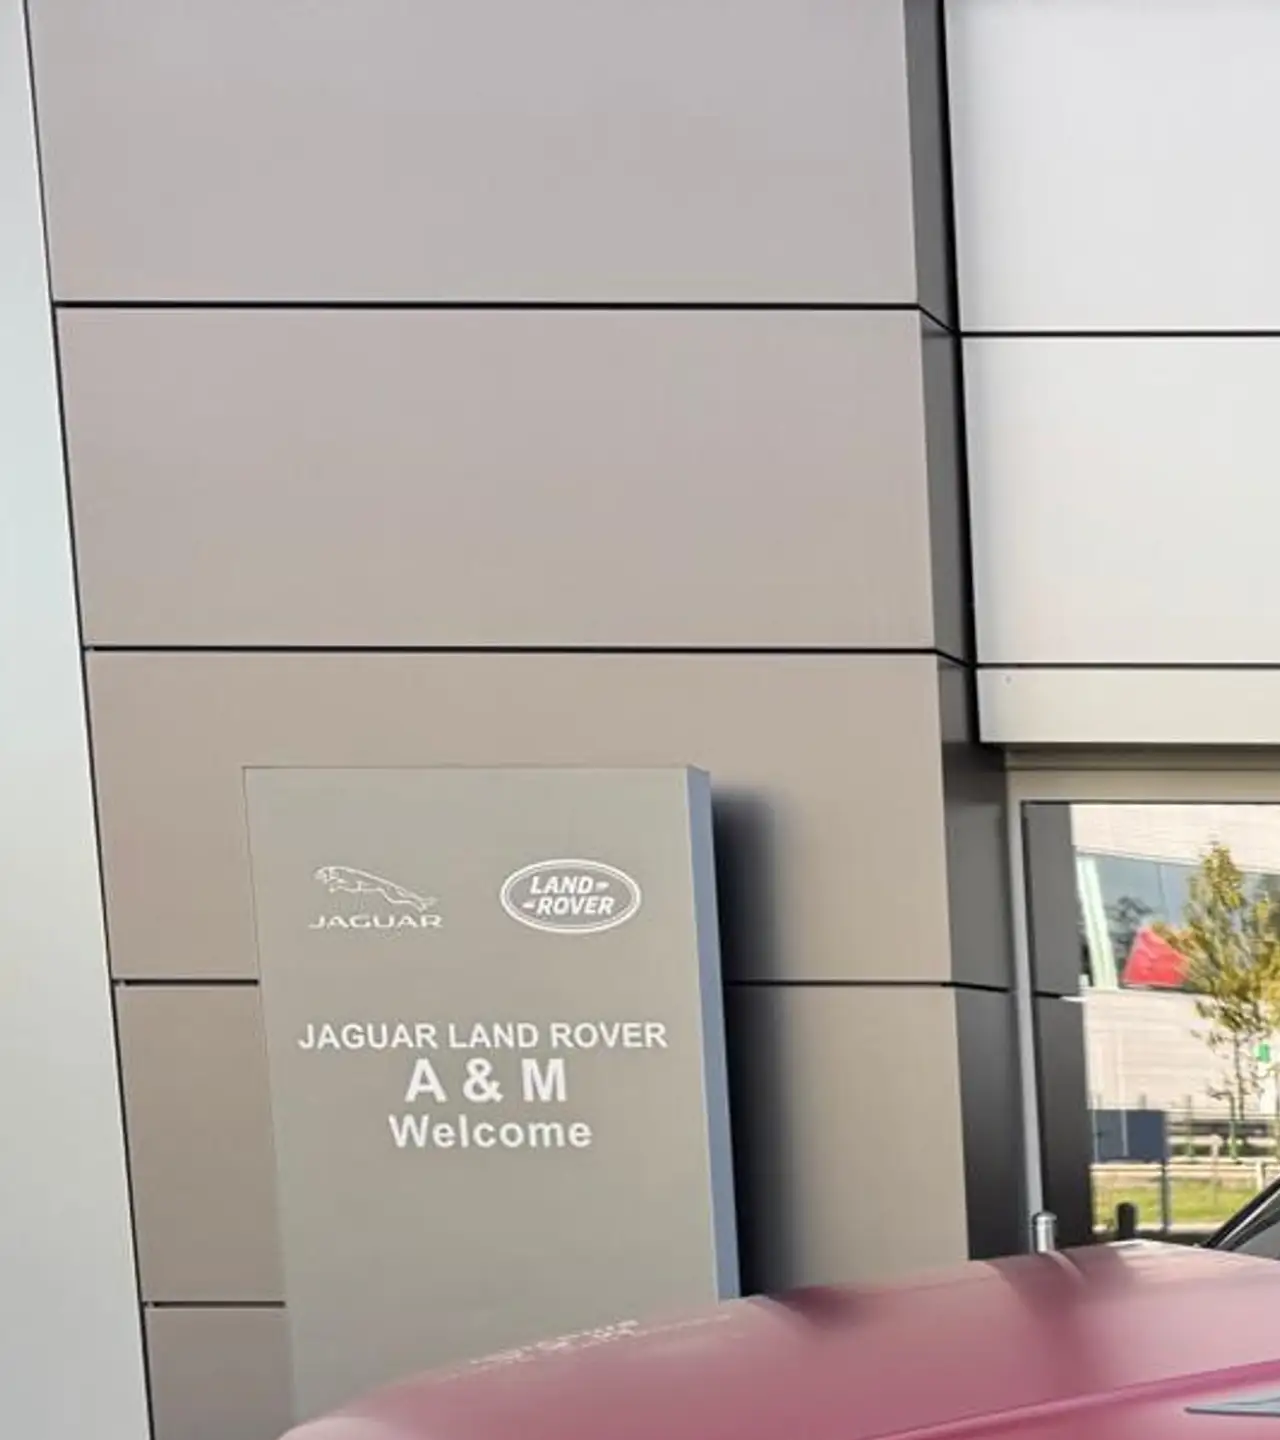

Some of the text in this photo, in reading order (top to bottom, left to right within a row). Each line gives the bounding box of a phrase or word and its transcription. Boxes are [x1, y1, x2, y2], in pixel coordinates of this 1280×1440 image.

[530, 875, 594, 894] LAND
[536, 896, 615, 916] ROVER
[308, 914, 443, 929] JAGUAR
[298, 1022, 669, 1049] JAGUAR LAND ROVER
[404, 1057, 568, 1103] A & M
[388, 1114, 593, 1148] Welcome
